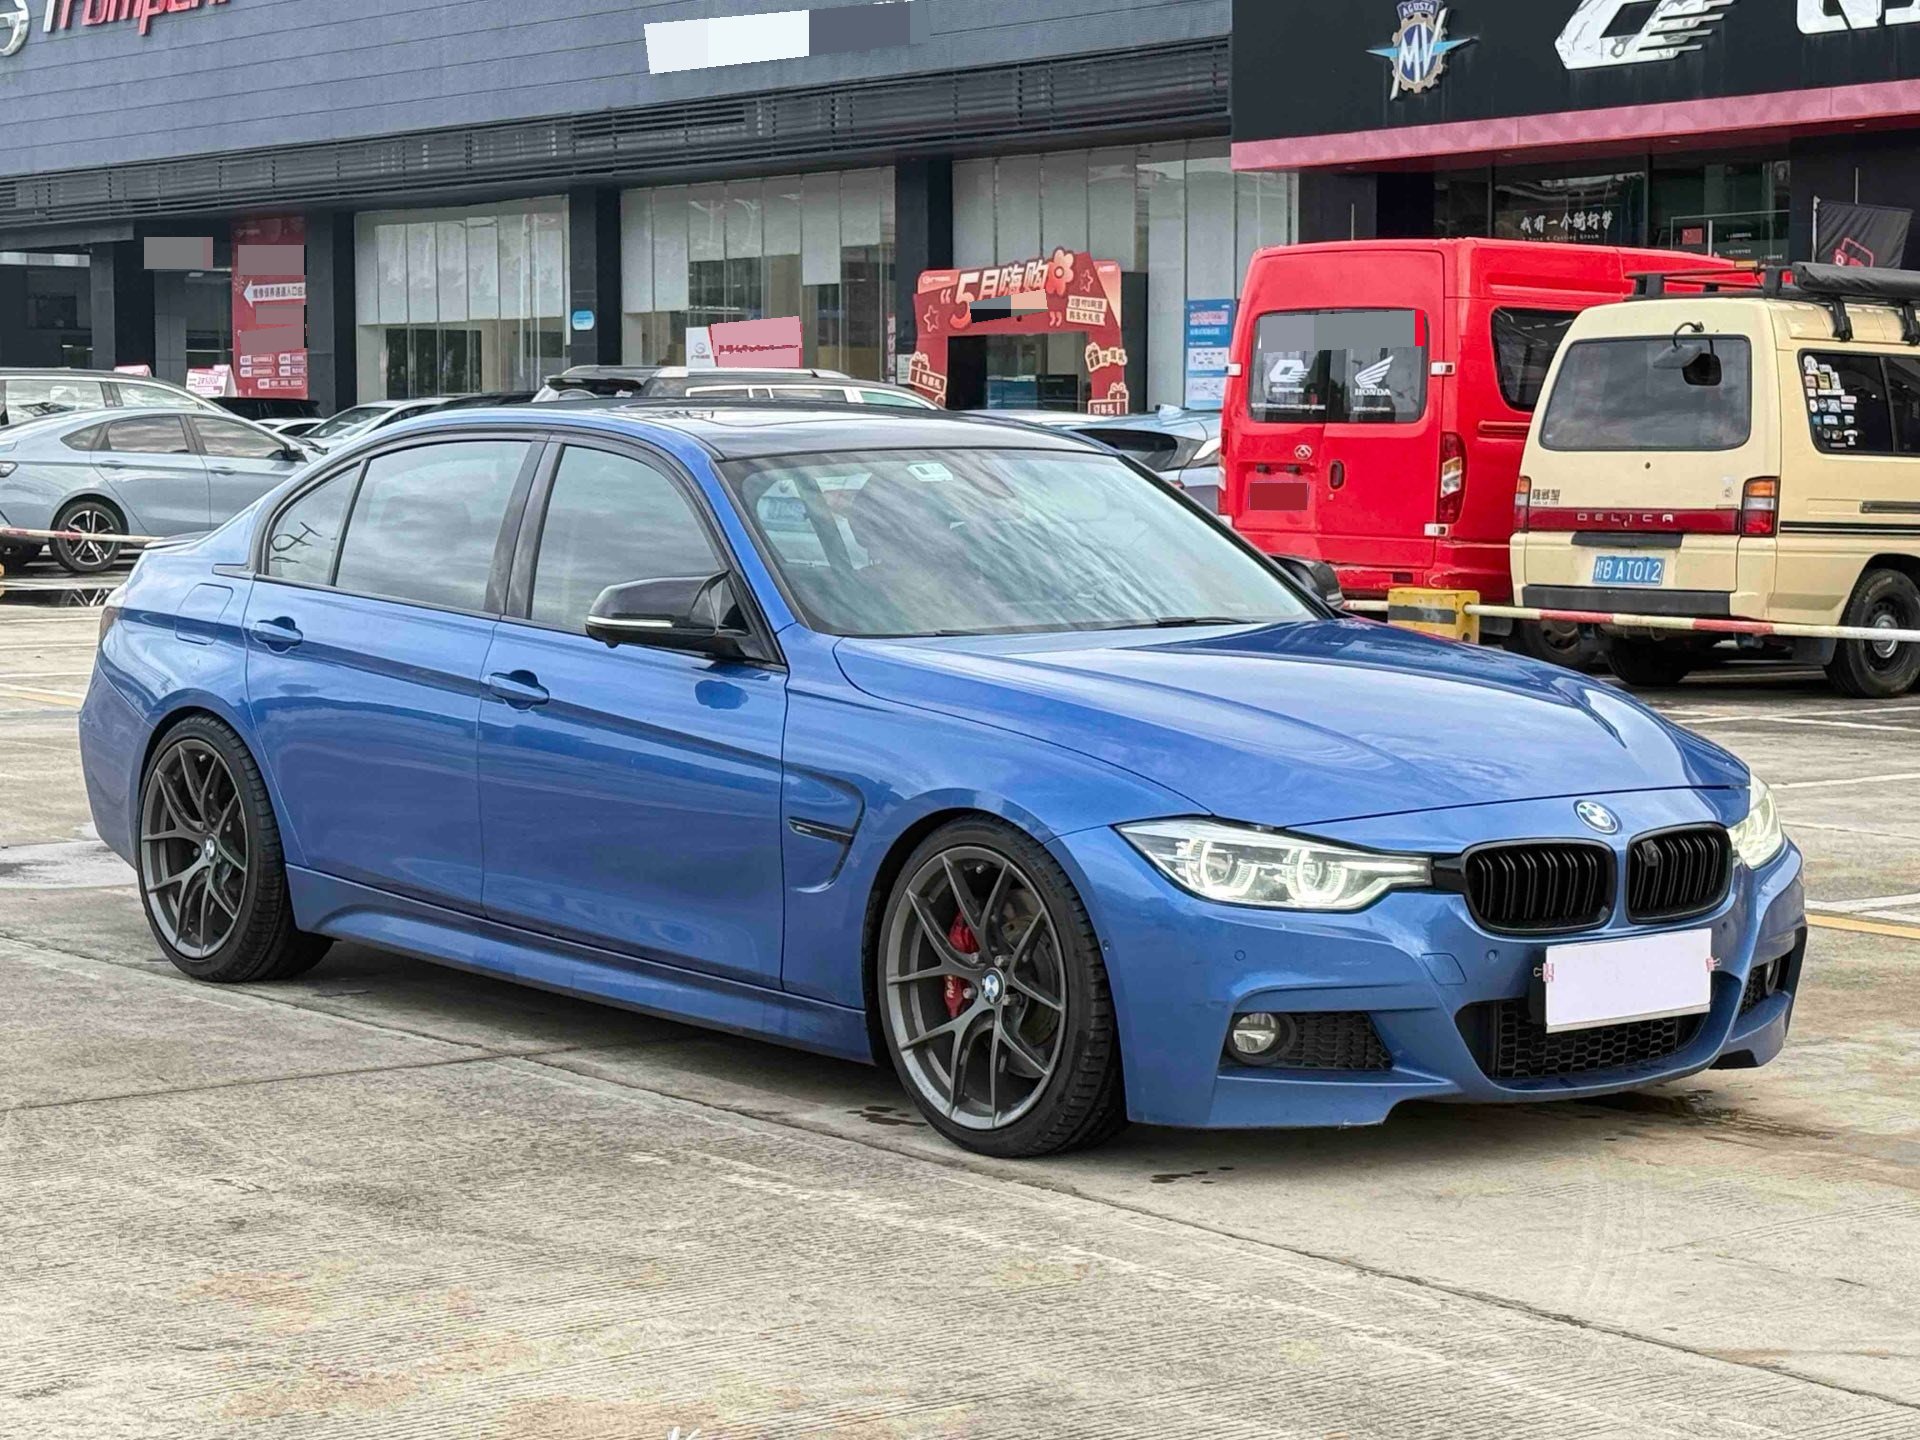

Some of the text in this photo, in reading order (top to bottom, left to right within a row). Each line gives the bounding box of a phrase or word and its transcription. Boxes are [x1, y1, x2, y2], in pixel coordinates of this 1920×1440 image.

[1402, 2, 1434, 16] AGUSTA
[1354, 388, 1391, 396] HONDA
[1577, 513, 1674, 523] DELICA
